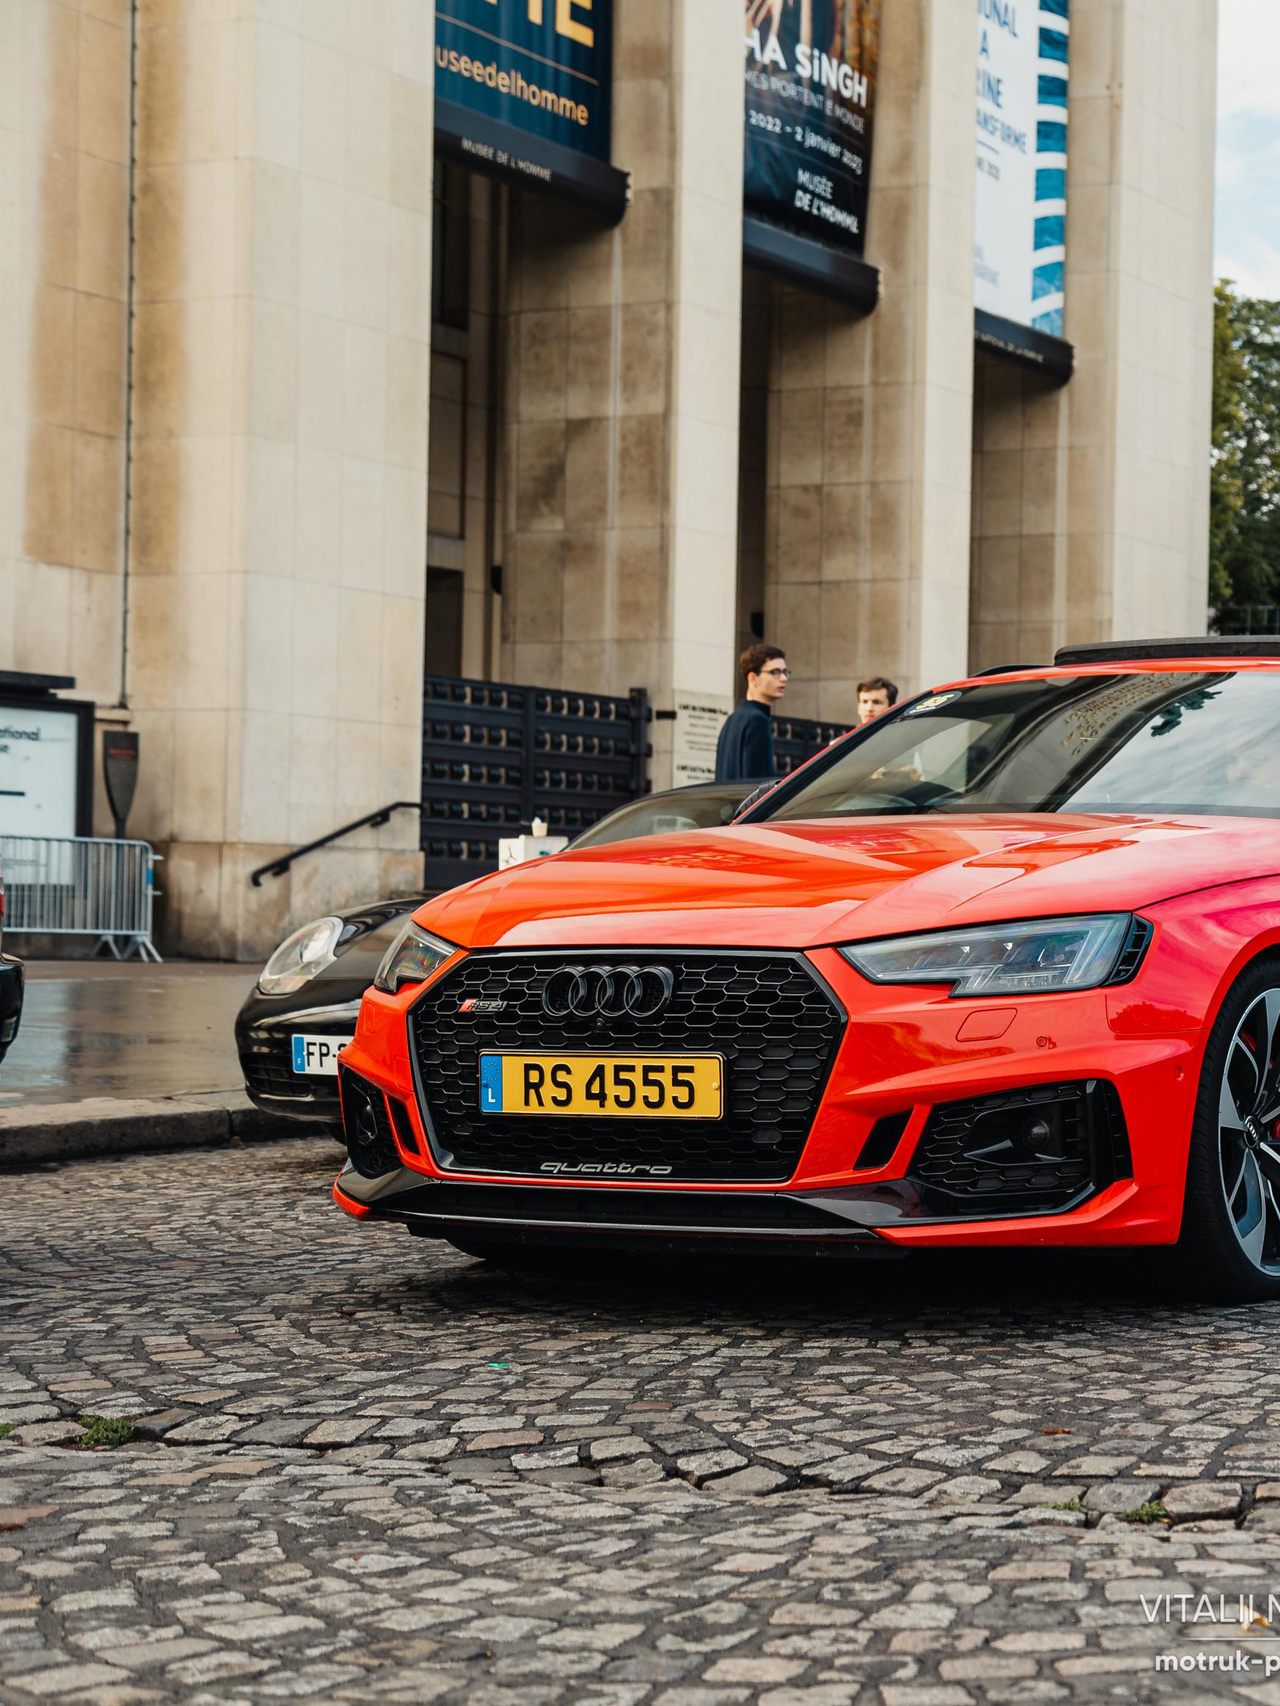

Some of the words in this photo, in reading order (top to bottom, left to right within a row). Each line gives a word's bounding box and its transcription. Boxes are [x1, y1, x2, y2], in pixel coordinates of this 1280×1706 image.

[748, 109, 782, 134] 2022
[794, 126, 804, 142] 2
[804, 126, 842, 159] janvier
[793, 189, 812, 212] DE
[306, 1041, 347, 1067] FP-
[523, 1062, 573, 1107] RS
[585, 1064, 695, 1109] 4555
[540, 1161, 672, 1174] quattro
